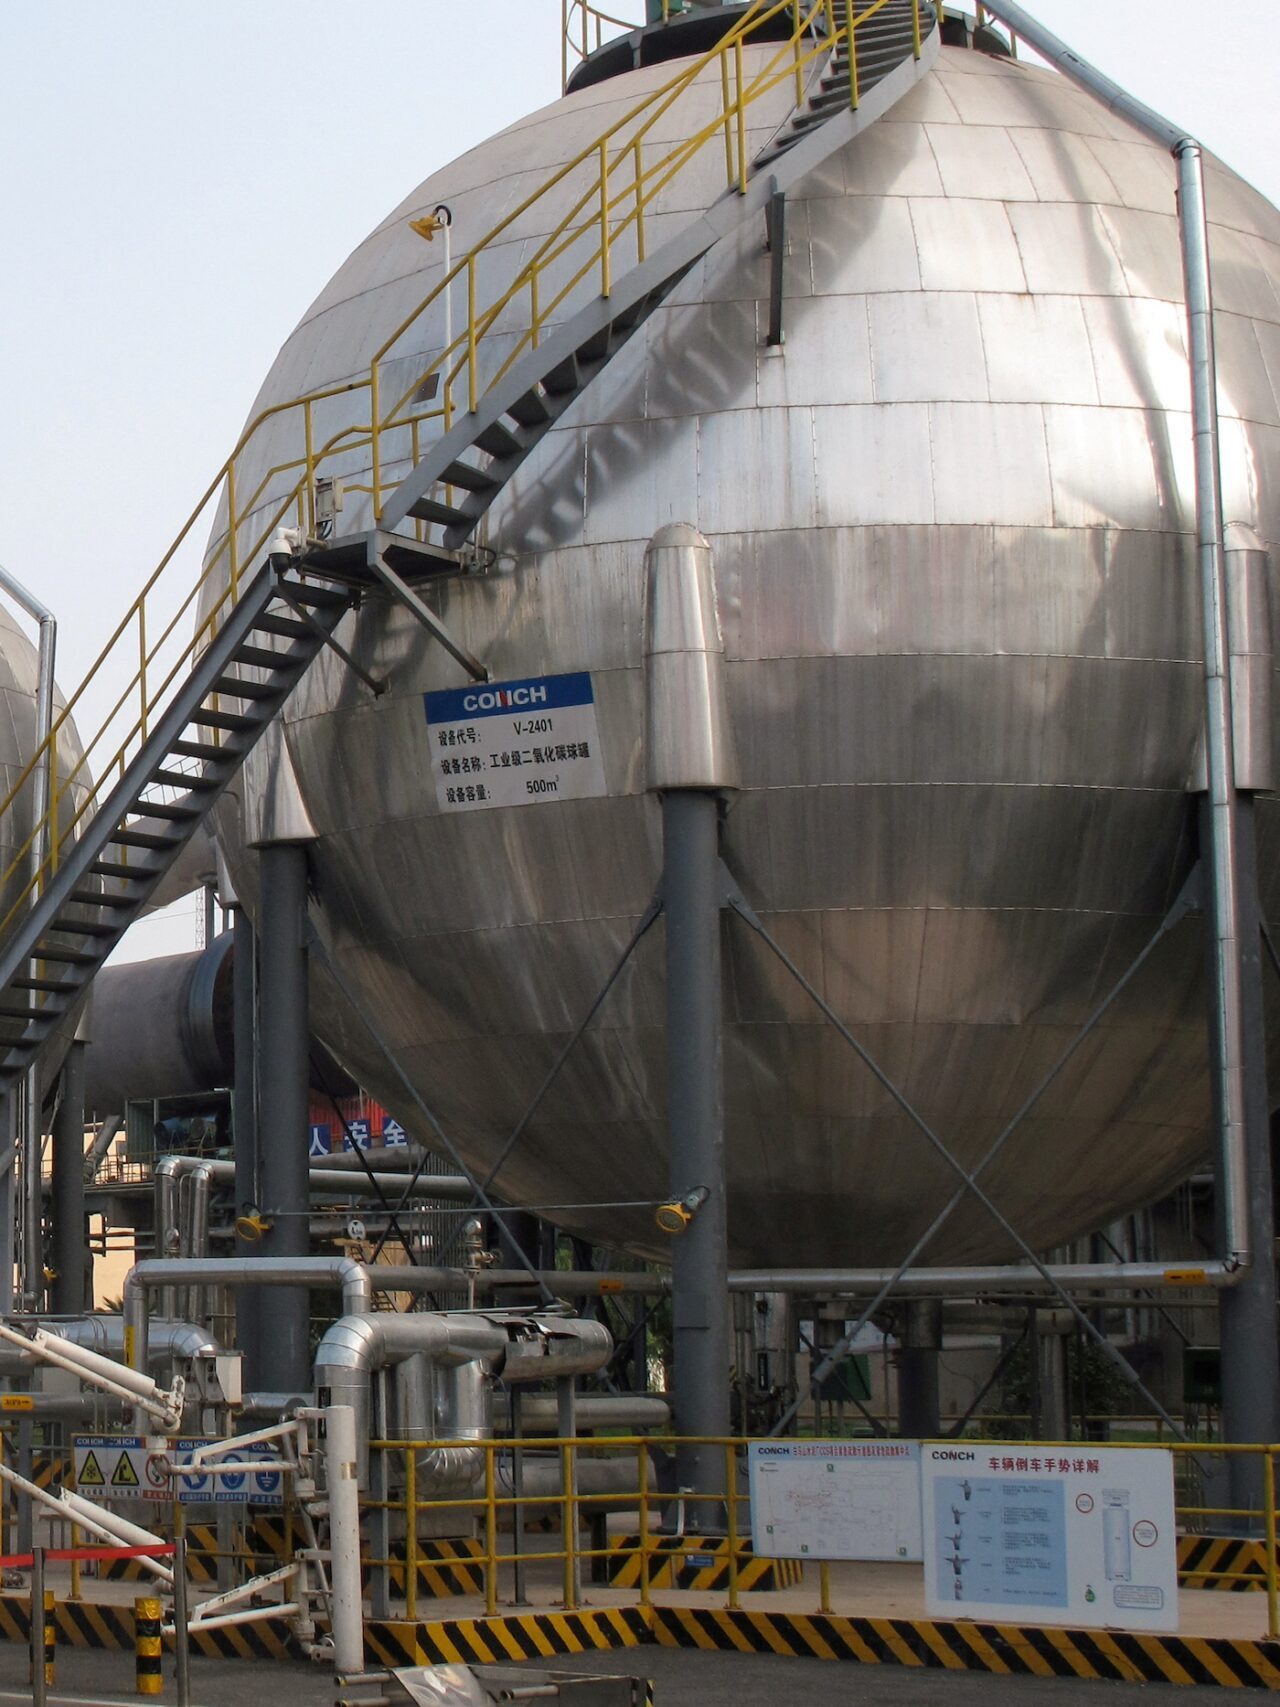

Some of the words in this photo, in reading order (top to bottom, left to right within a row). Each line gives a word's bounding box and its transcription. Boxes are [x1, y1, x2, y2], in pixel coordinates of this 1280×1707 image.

[463, 685, 547, 712] CONCH
[513, 718, 553, 735] V-2401
[489, 742, 590, 768] 工业级二氧化碳球罐
[758, 1447, 790, 1455] CONCH
[932, 1450, 975, 1461] CONCH
[988, 1457, 1100, 1473] 车辆倒车手势详解
